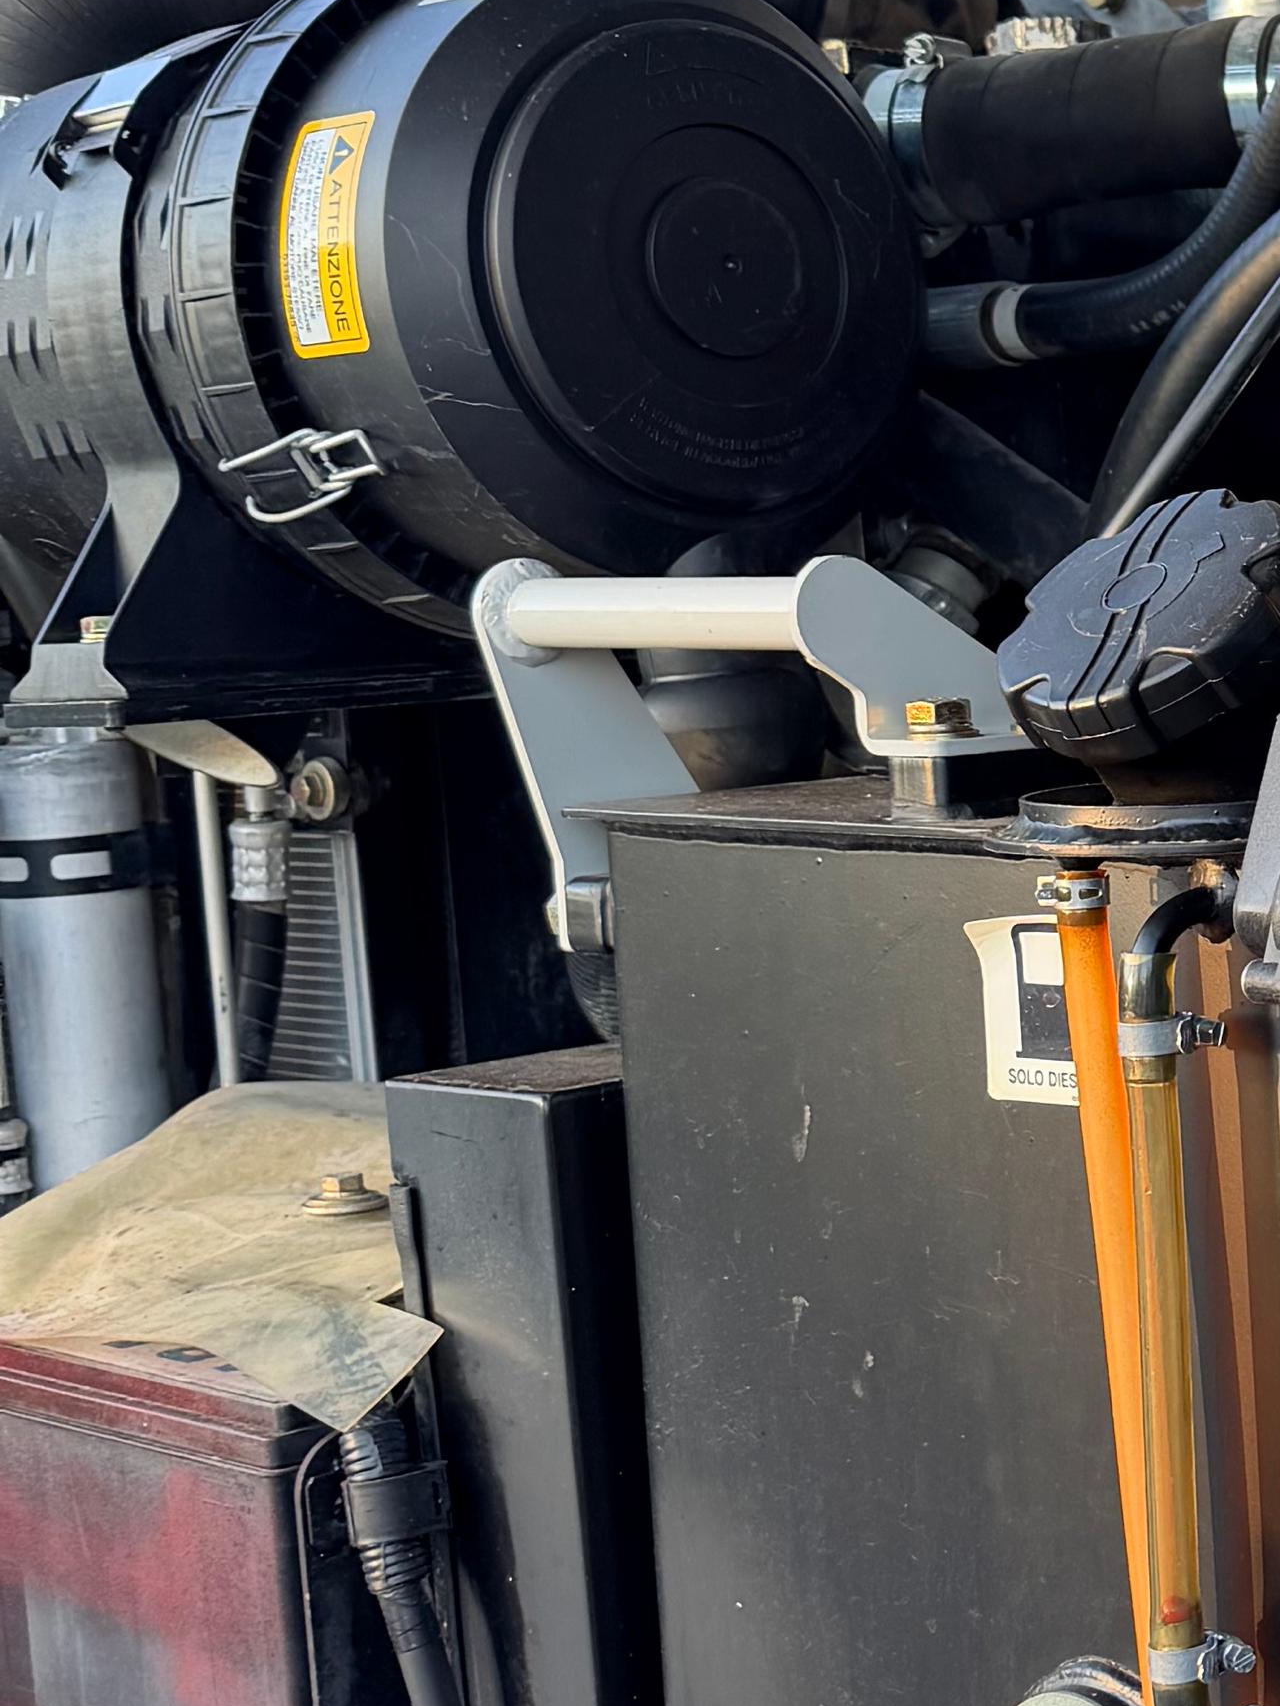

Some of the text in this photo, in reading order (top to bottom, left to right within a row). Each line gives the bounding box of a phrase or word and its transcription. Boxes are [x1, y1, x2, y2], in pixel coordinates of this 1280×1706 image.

[326, 178, 351, 333] ATTENZIONE
[1008, 1068, 1078, 1089] SOLO DIES
